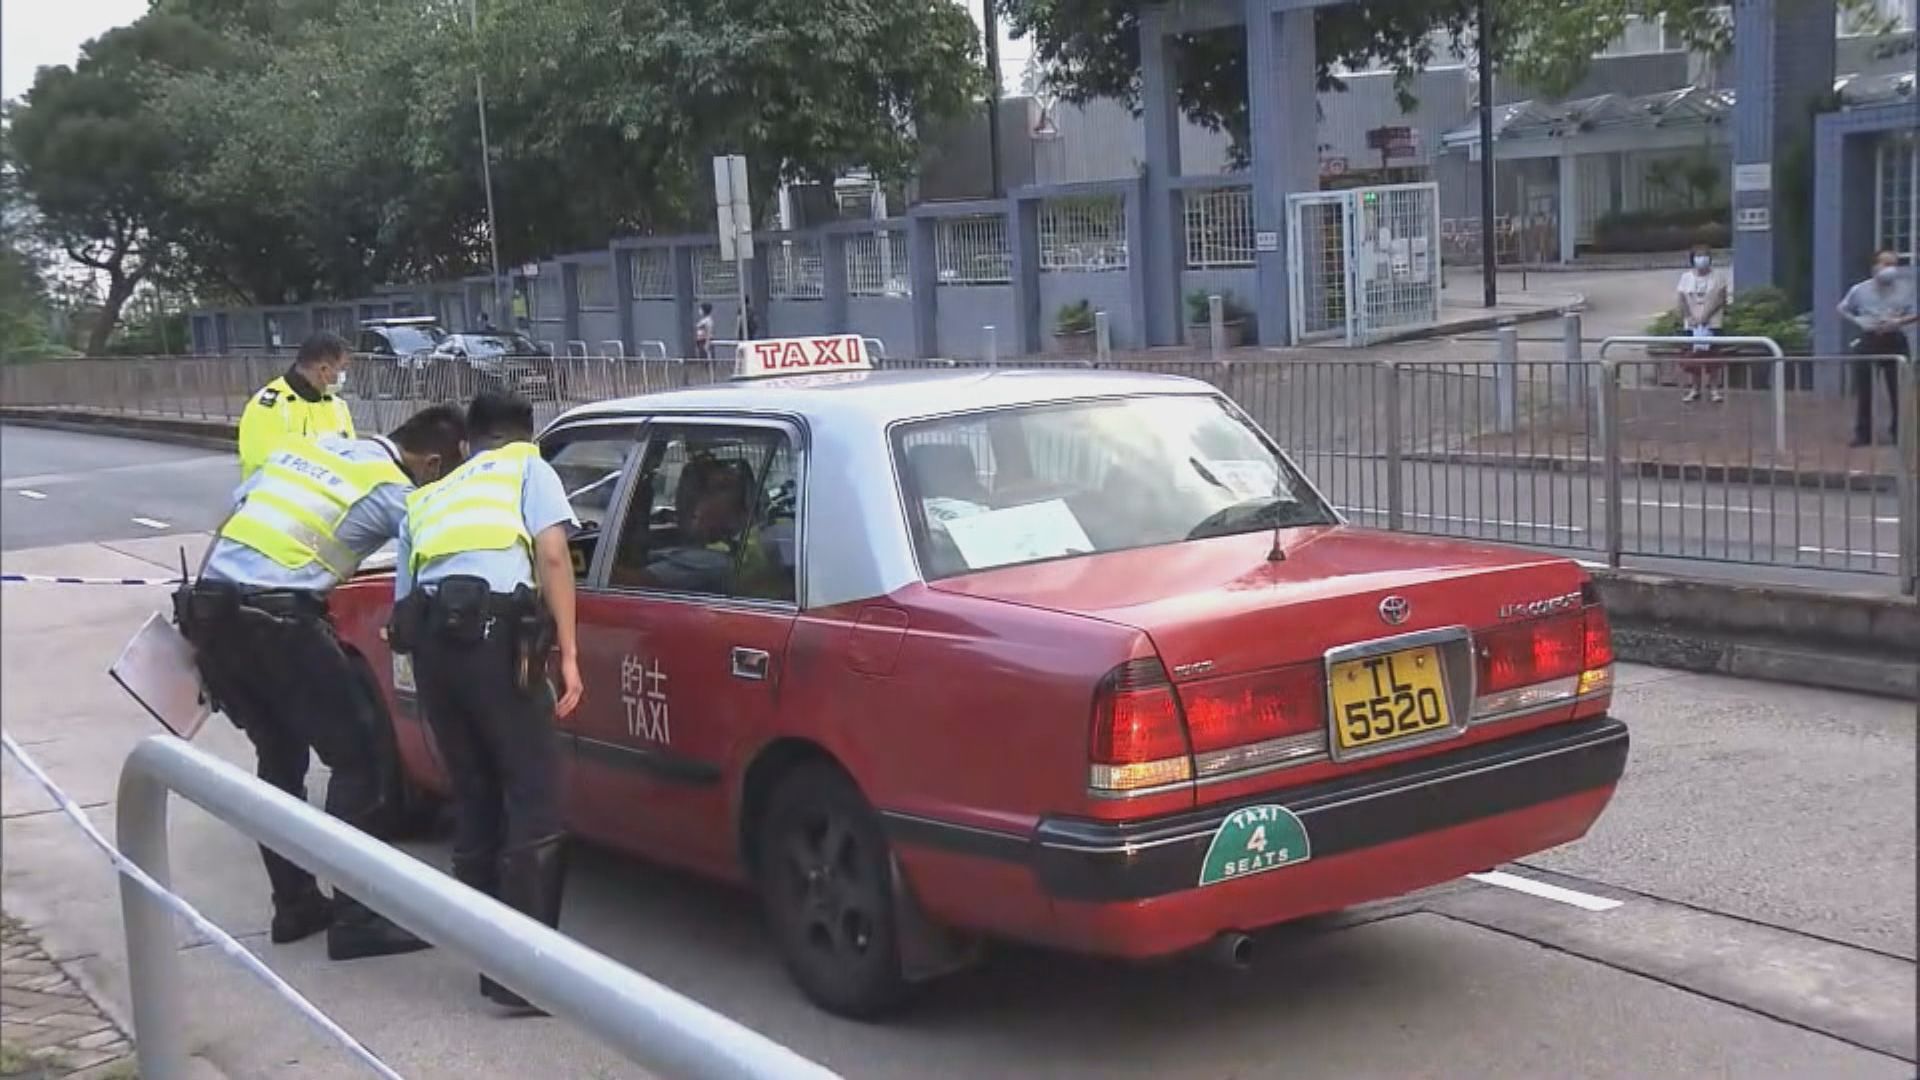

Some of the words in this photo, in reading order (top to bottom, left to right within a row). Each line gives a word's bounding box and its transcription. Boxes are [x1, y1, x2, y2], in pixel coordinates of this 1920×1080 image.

[754, 337, 861, 369] TAXI
[621, 654, 667, 700] 的士
[1361, 655, 1413, 698] TL
[621, 695, 670, 745] TAXI
[1344, 687, 1442, 741] 5520
[1233, 807, 1278, 830] TAXI
[1246, 825, 1268, 852] 4
[1224, 848, 1289, 876] SEATS
